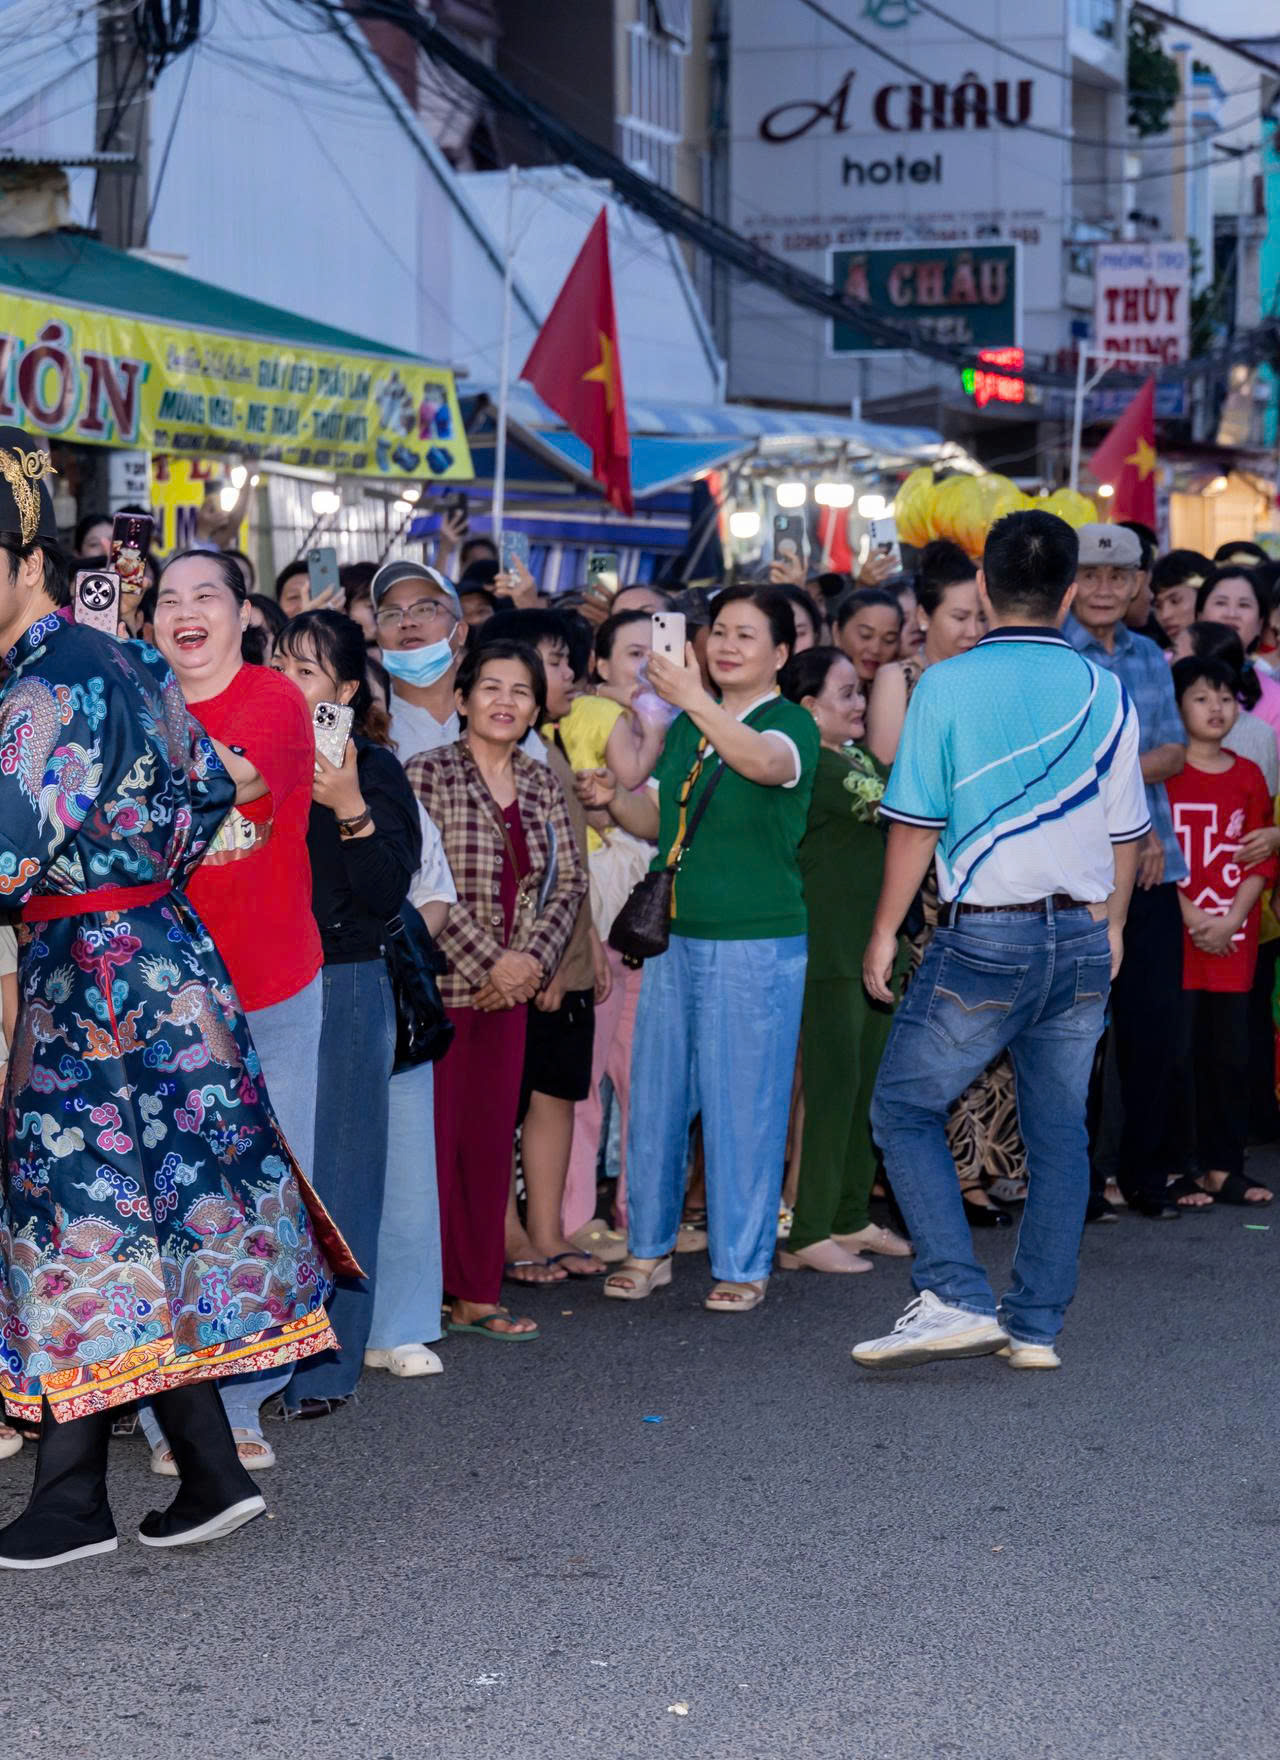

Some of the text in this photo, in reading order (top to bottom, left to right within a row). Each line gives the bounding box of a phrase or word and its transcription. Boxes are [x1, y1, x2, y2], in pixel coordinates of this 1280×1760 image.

[873, 70, 1033, 132] CHÂU
[841, 153, 942, 186] hotel
[888, 252, 1007, 307] CHÂU
